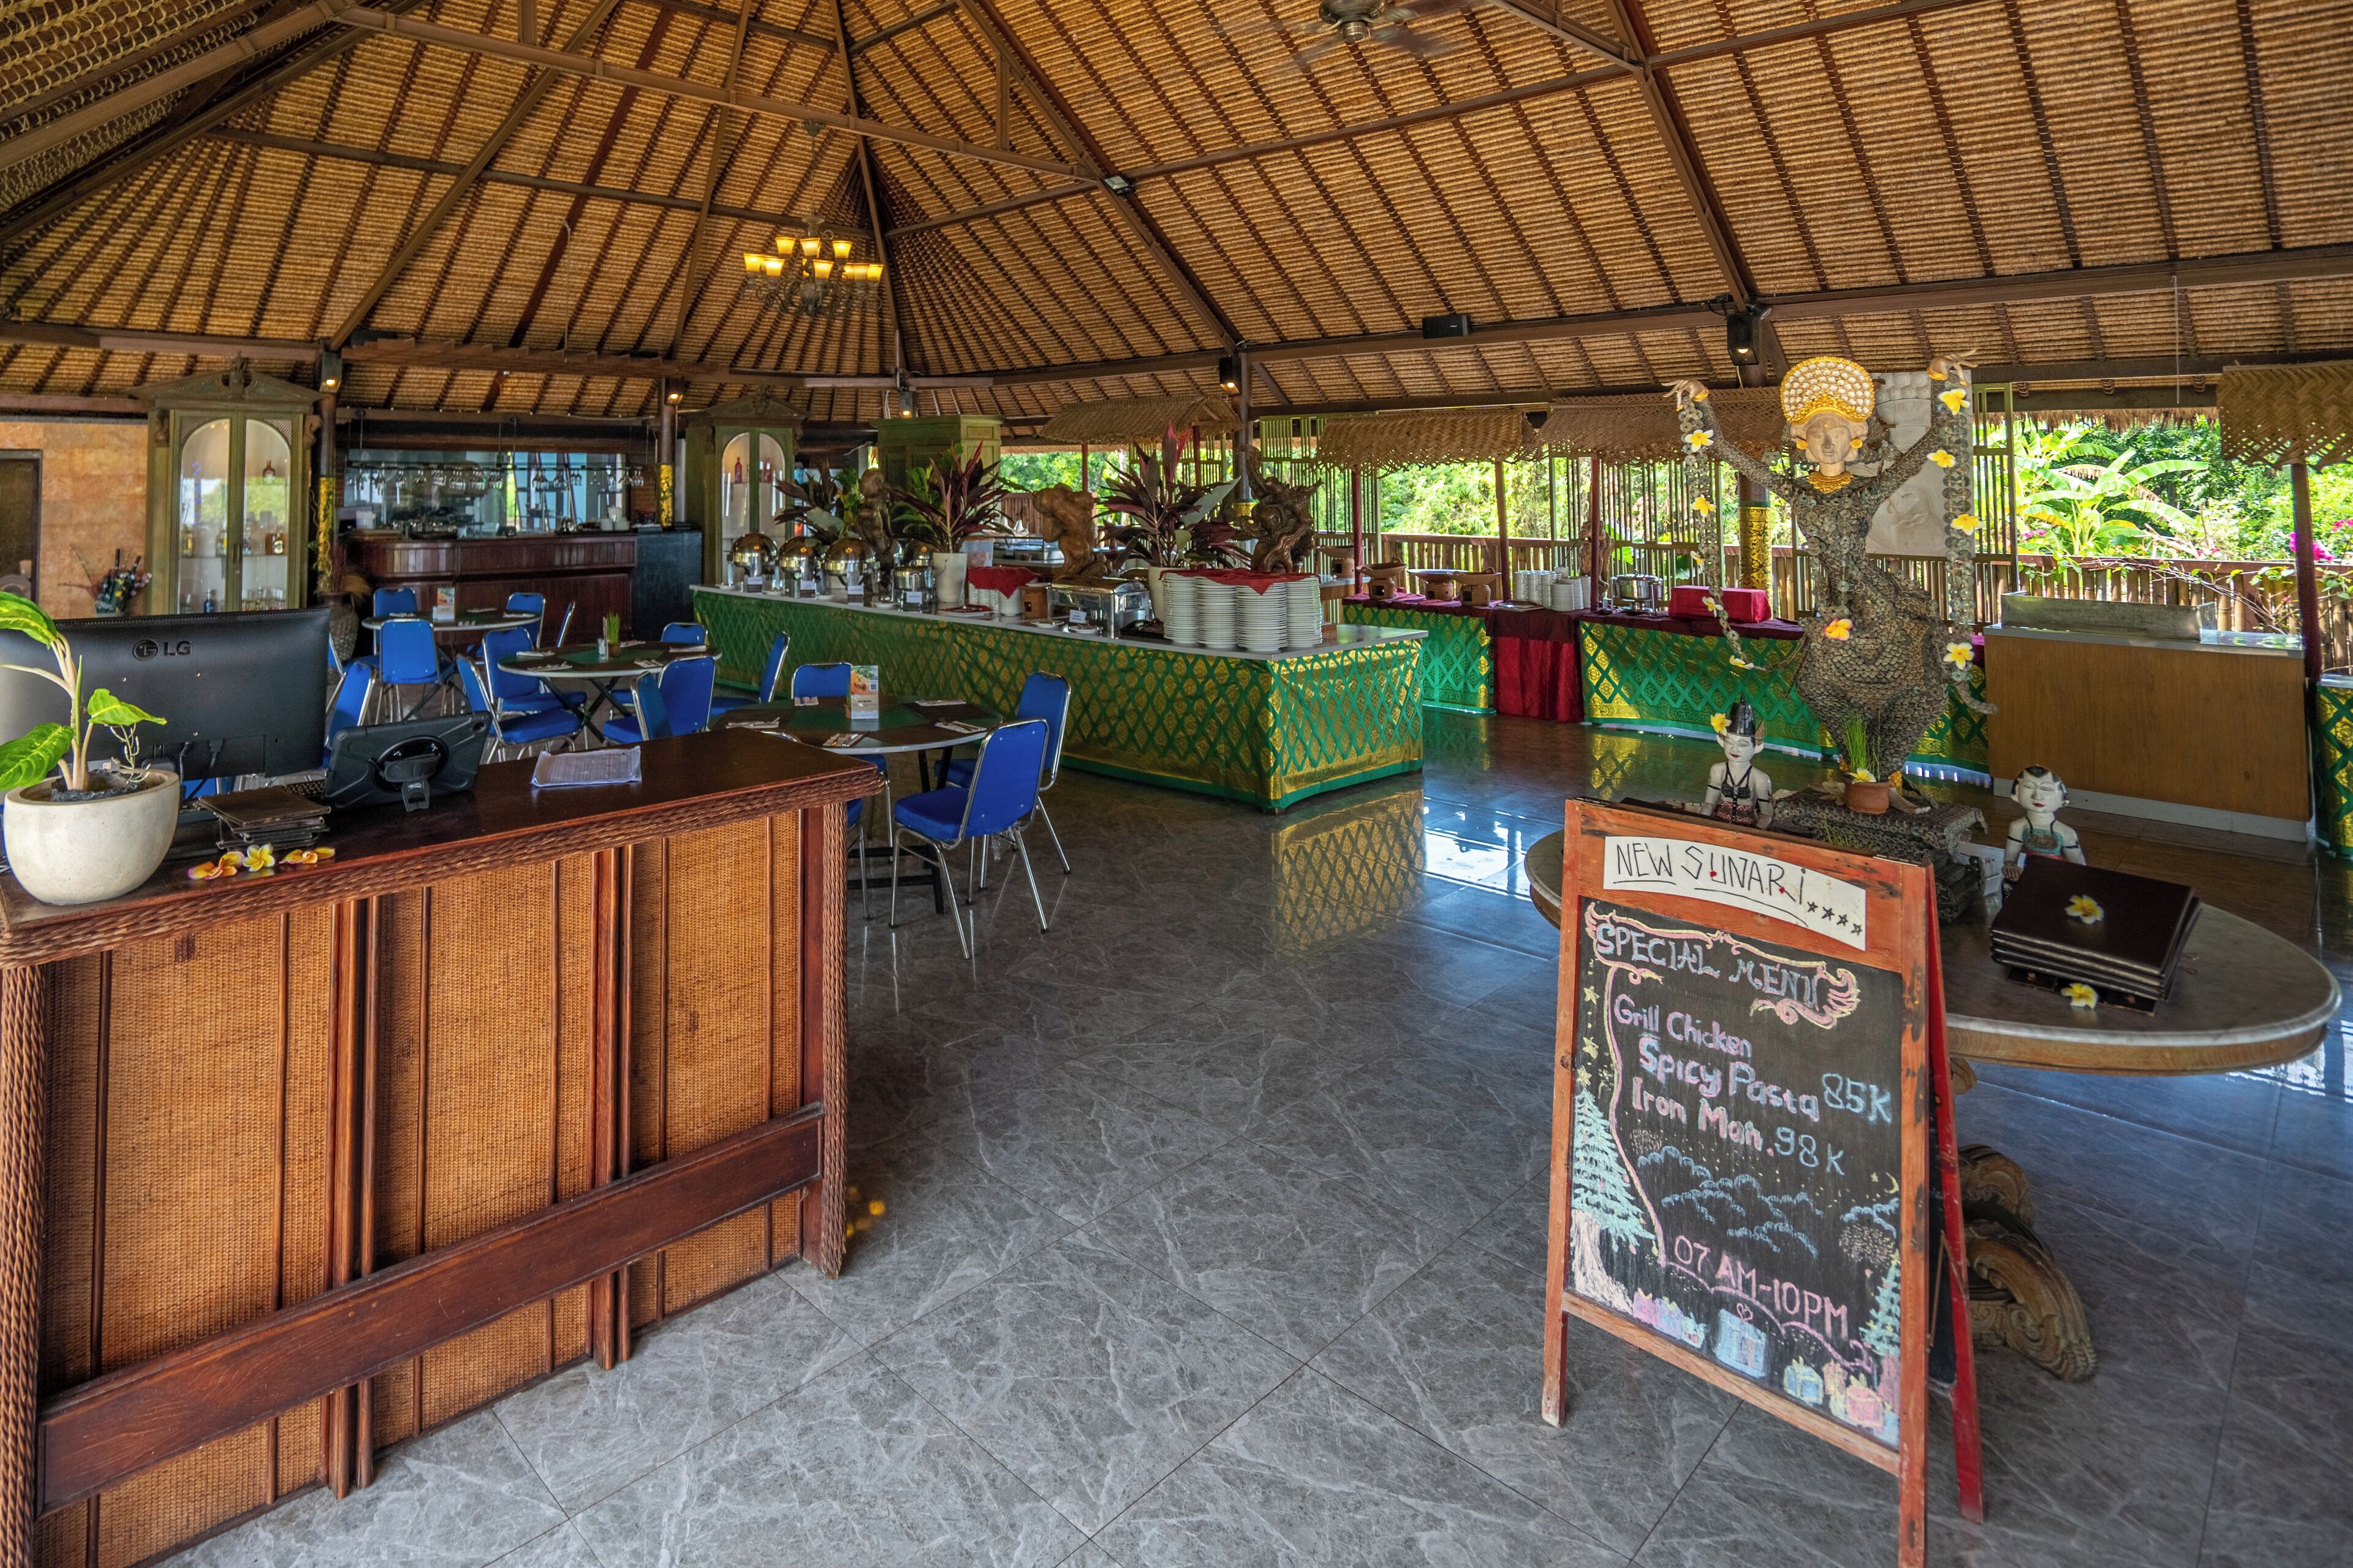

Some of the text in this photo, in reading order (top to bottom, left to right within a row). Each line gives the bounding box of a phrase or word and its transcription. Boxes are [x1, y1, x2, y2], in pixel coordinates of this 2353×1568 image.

[163, 640, 192, 656] LG
[1616, 843, 1673, 877] NEW
[1596, 923, 1820, 1011] SPECIAL MENU
[1613, 993, 1752, 1060] Grill Chicken
[1632, 1076, 1687, 1124] Iron
[1638, 1037, 1722, 1098] Spicy
[1728, 1061, 1820, 1123] Pasta
[1674, 1235, 1711, 1273] 07
